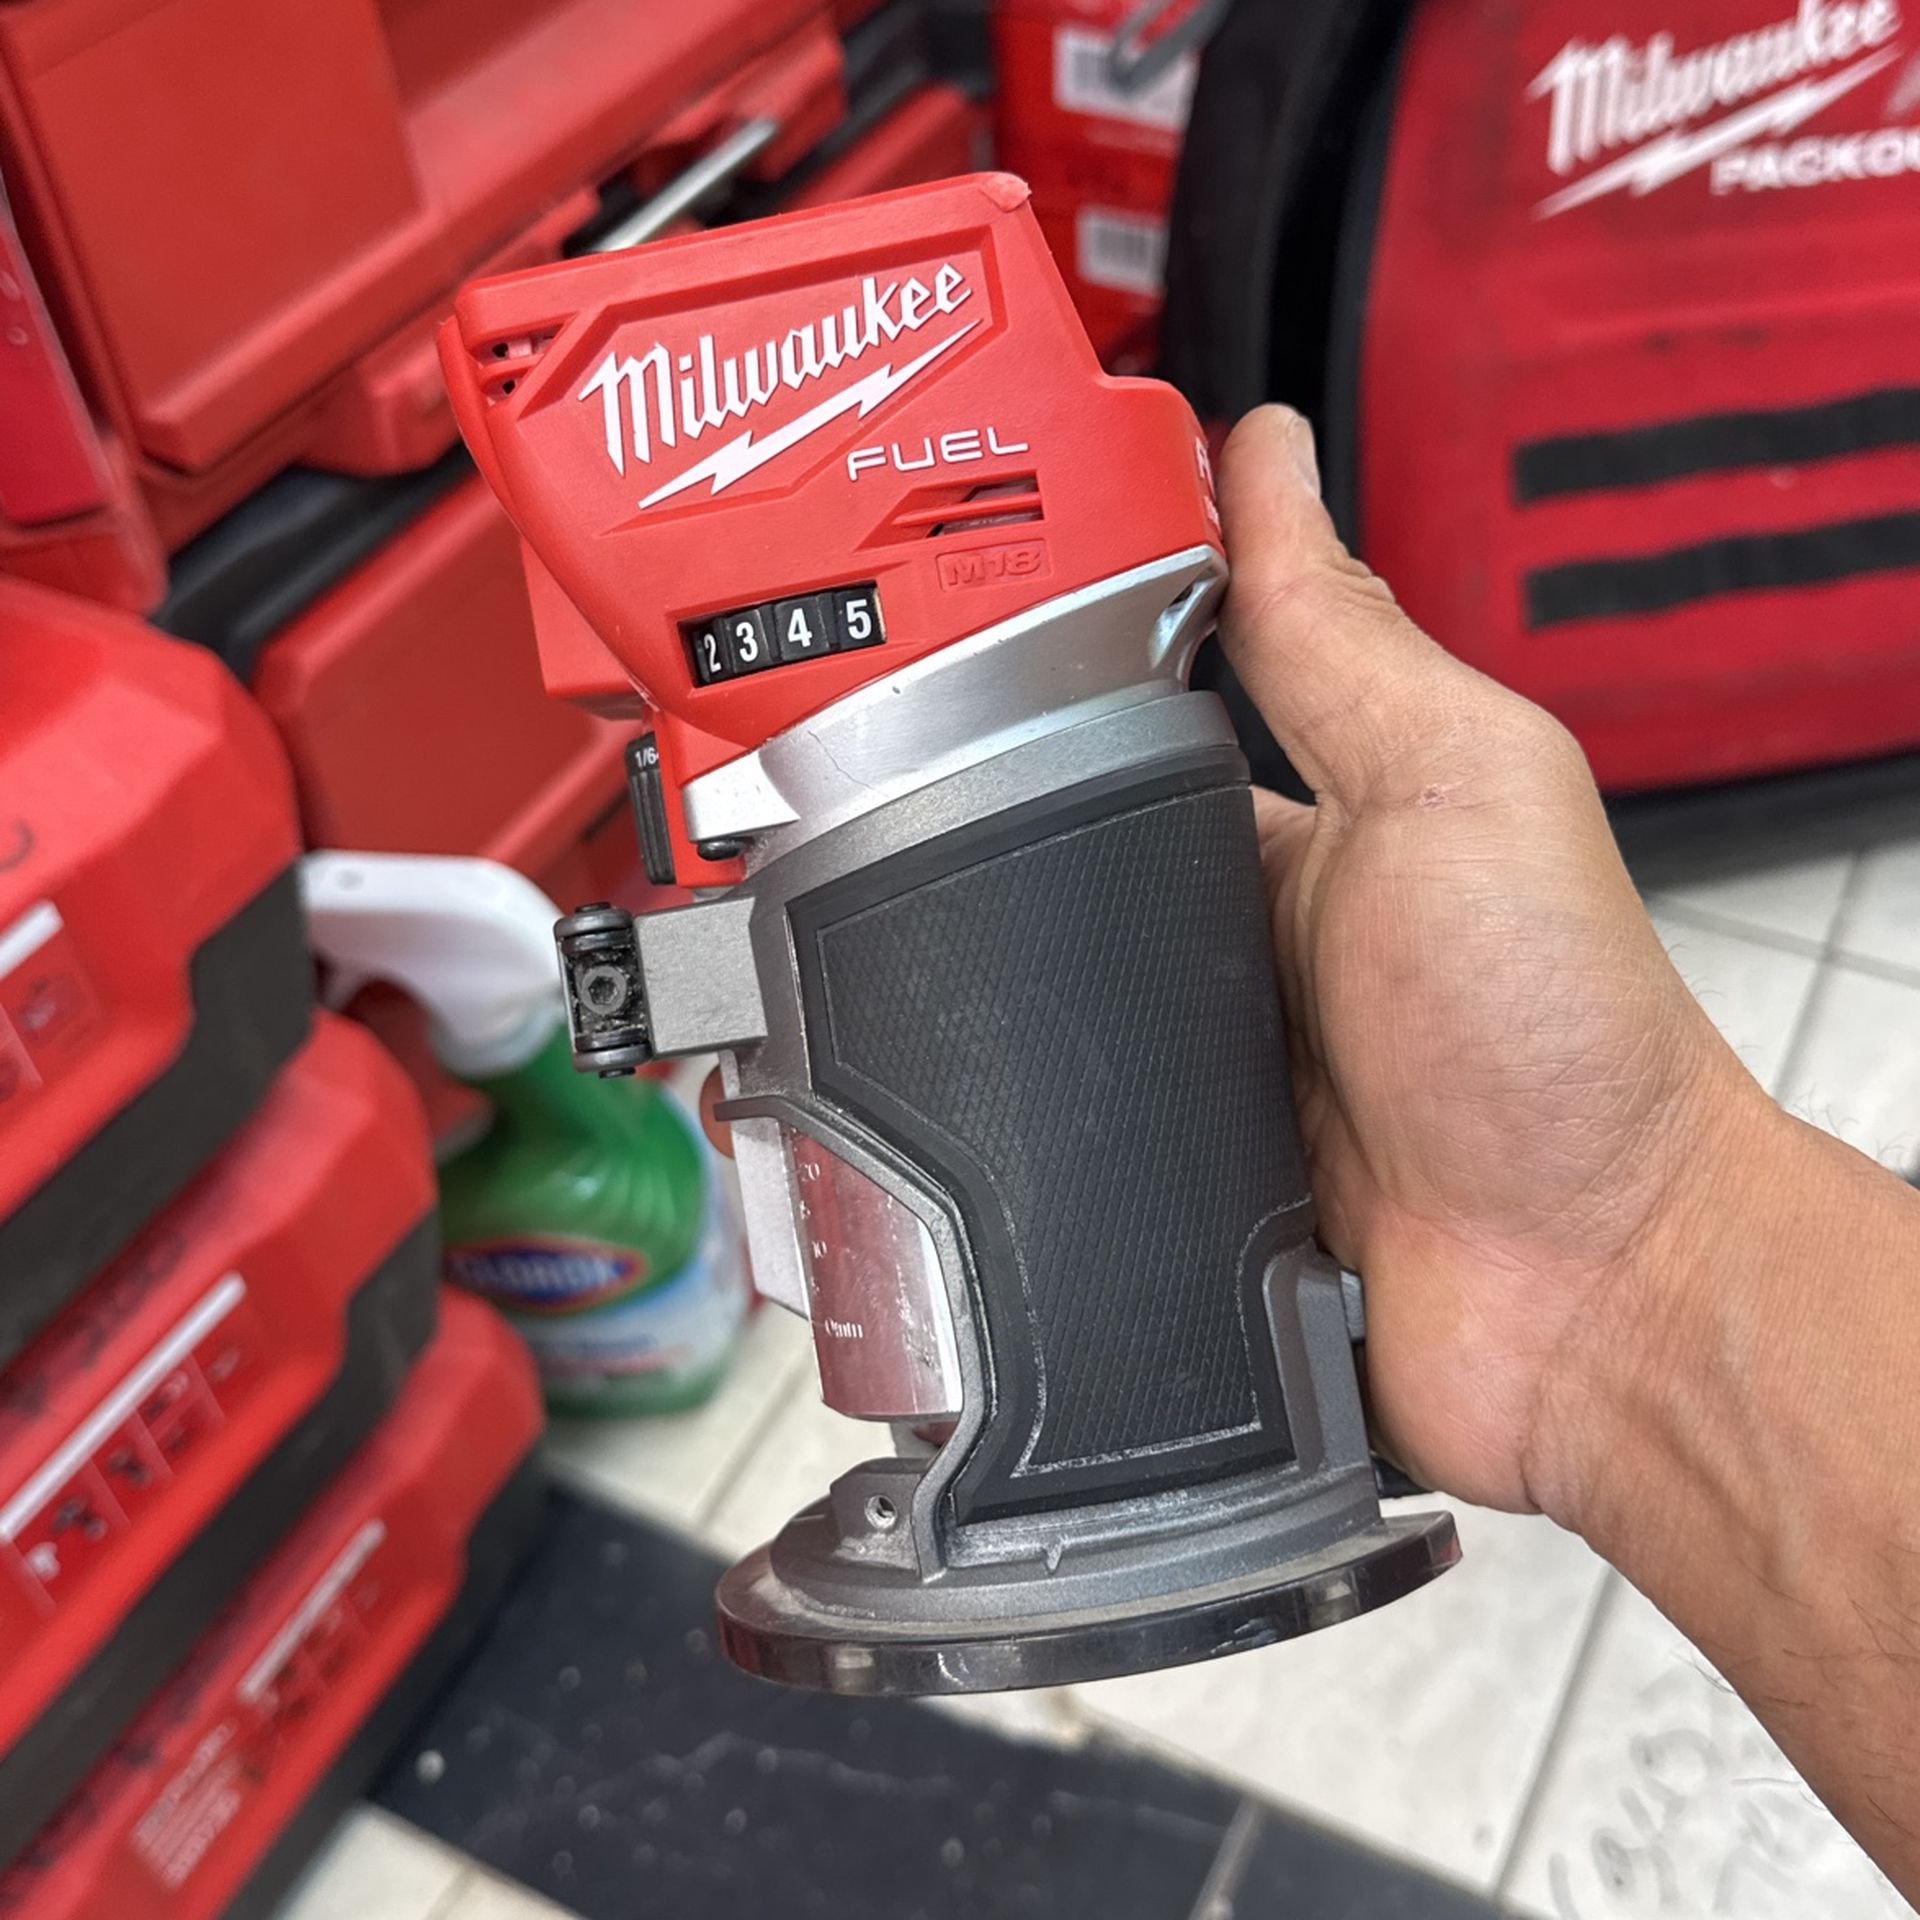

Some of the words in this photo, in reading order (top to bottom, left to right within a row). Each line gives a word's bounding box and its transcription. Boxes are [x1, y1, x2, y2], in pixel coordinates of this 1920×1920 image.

[578, 263, 973, 477] Milwaukee
[846, 426, 1029, 481] FUEL
[946, 549, 1042, 587] M18
[703, 633, 722, 673] 2
[736, 621, 759, 662] 3
[788, 607, 813, 648] 4
[845, 599, 872, 640] 5
[635, 746, 659, 768] 1/6
